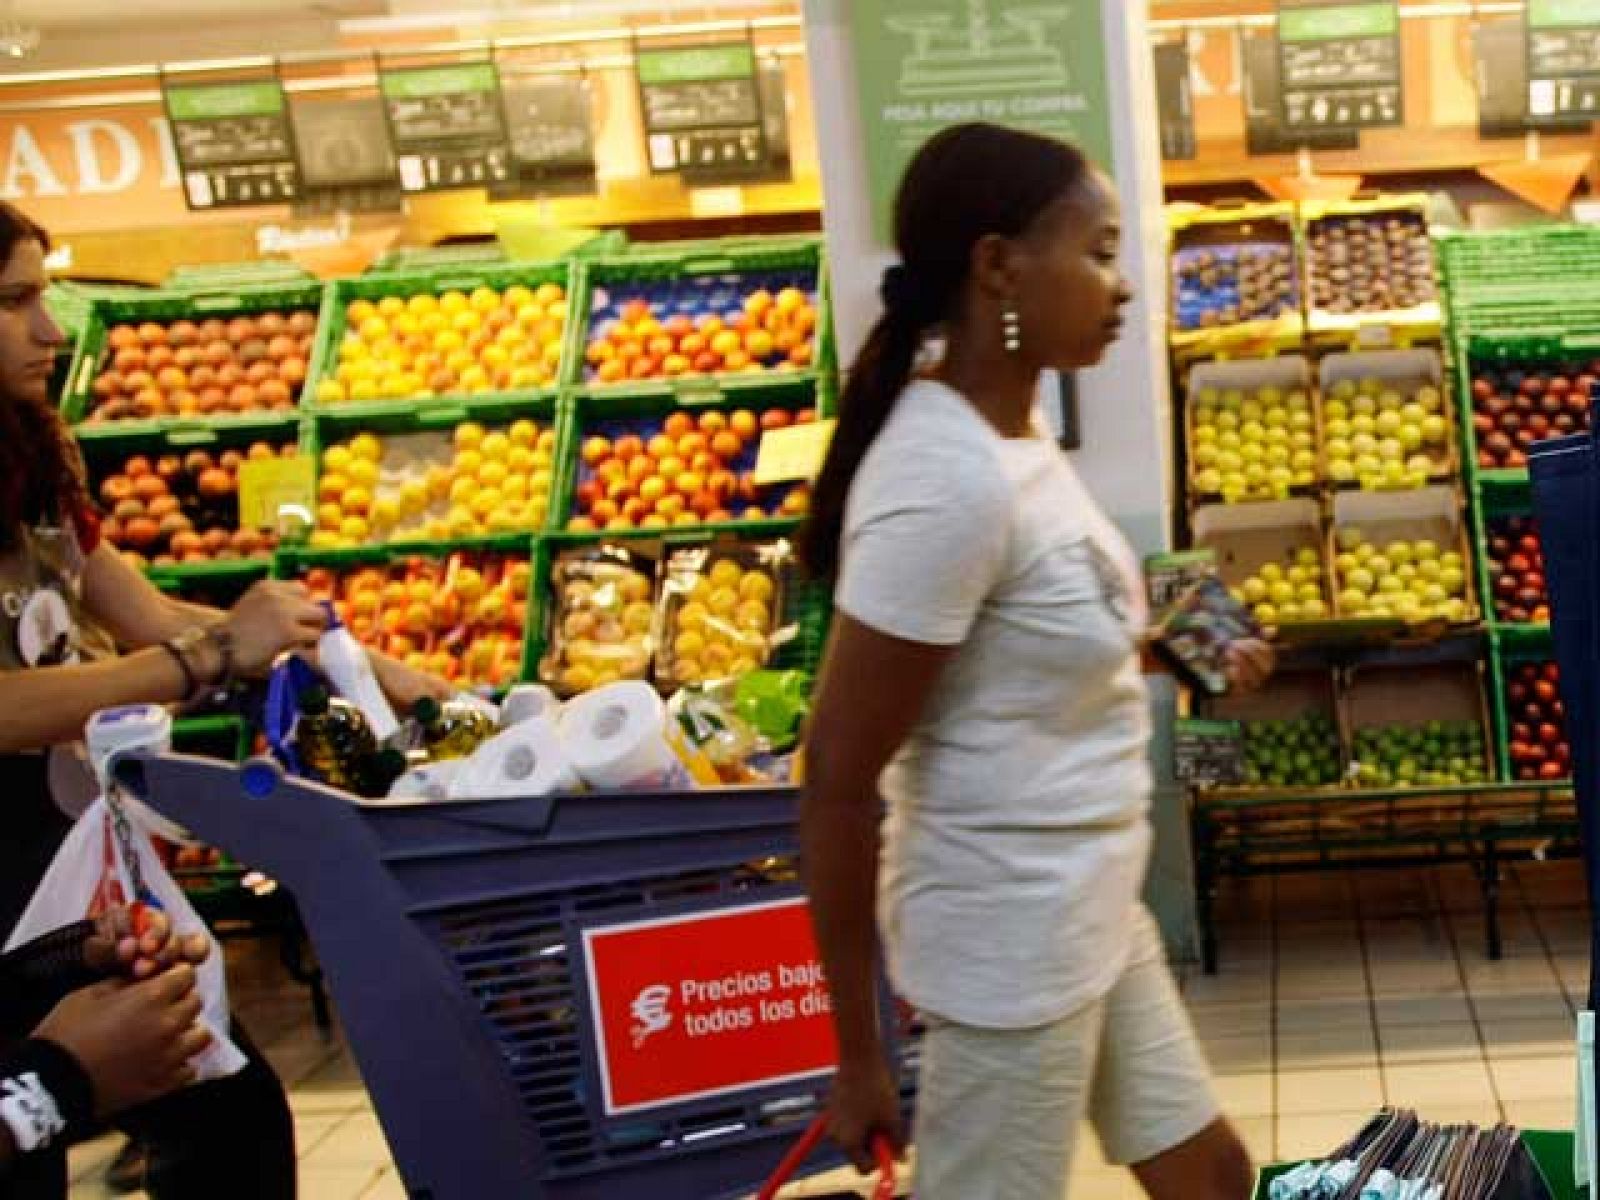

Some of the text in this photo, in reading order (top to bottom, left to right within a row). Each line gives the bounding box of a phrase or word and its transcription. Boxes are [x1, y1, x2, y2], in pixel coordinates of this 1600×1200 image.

[680, 970, 773, 1005] Precios
[684, 1006, 755, 1037] todos
[759, 998, 796, 1022] los
